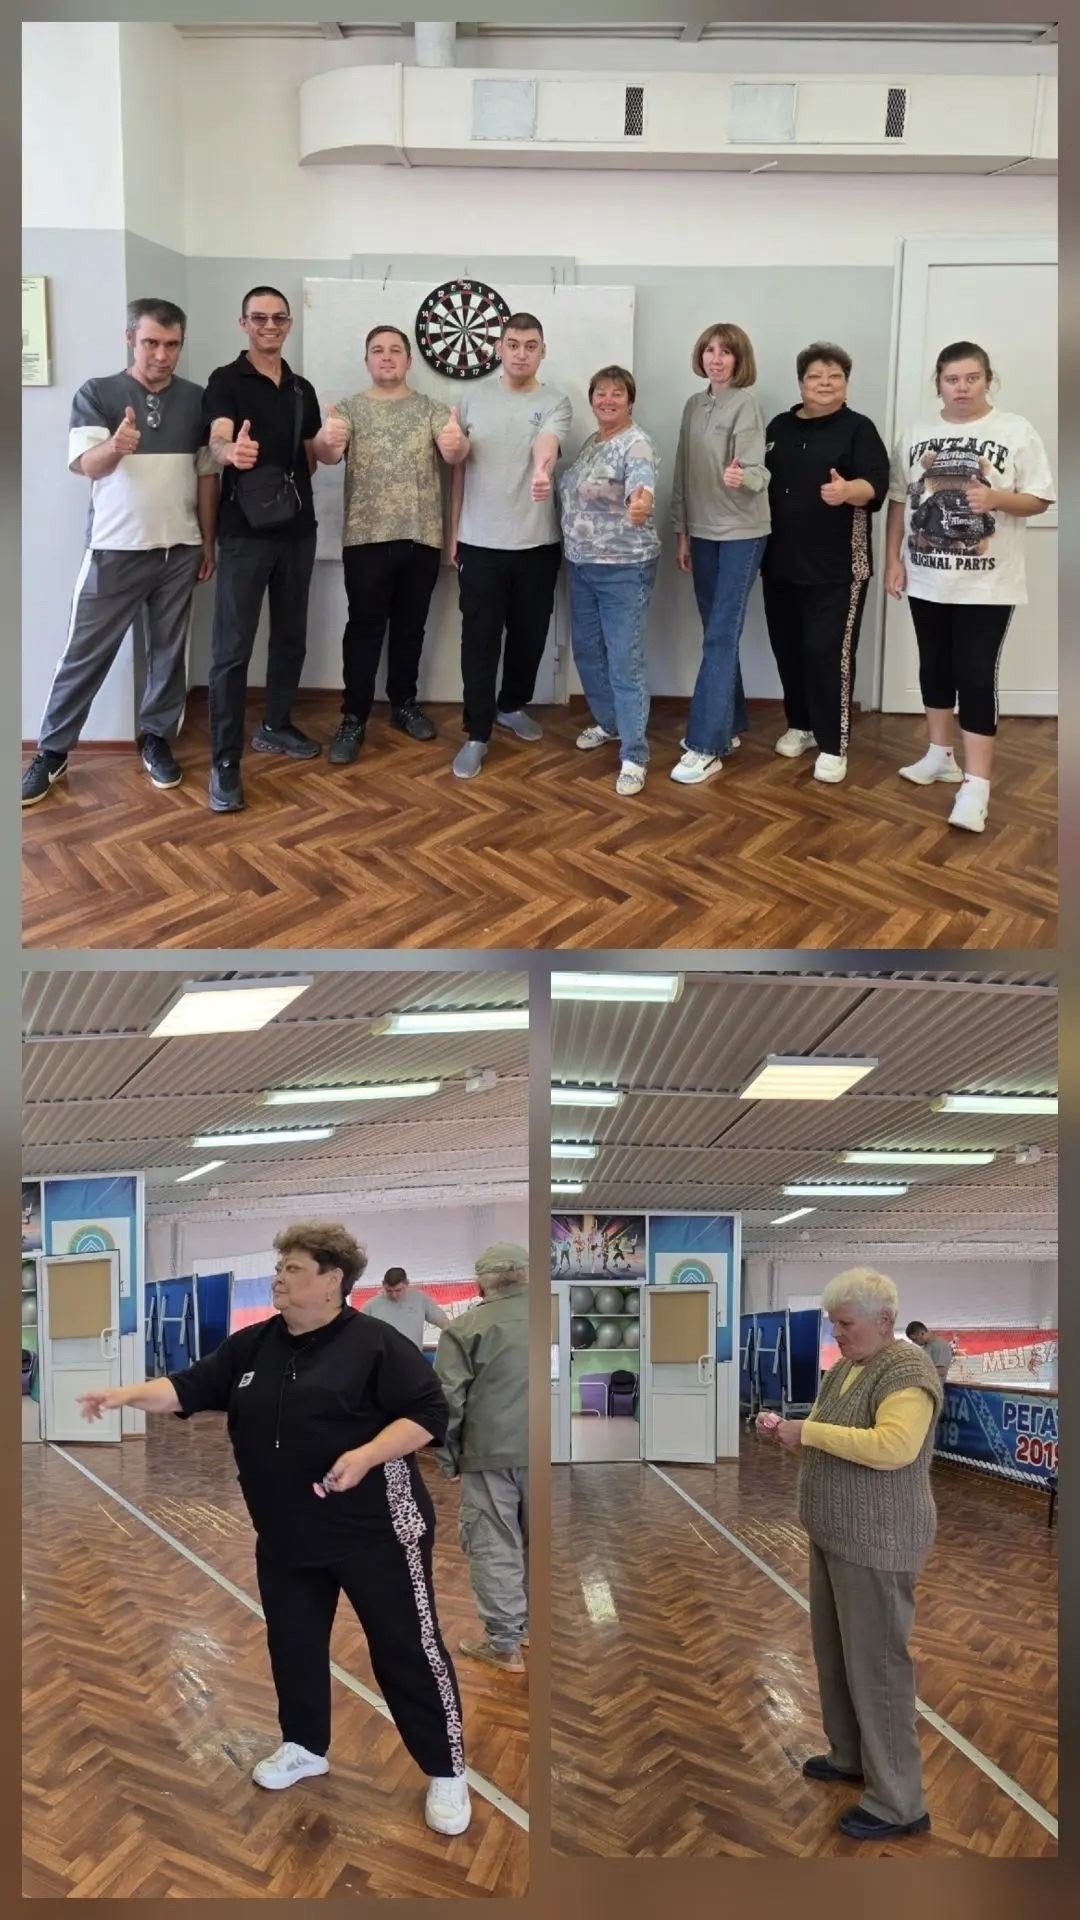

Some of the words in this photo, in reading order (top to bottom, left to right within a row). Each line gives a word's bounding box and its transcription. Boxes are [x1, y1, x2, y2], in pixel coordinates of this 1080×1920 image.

[909, 437, 1009, 474] VINTAGE
[956, 557, 996, 571] PARTS
[982, 1346, 1025, 1374] МЫ
[1002, 1400, 1058, 1440] РЕГА
